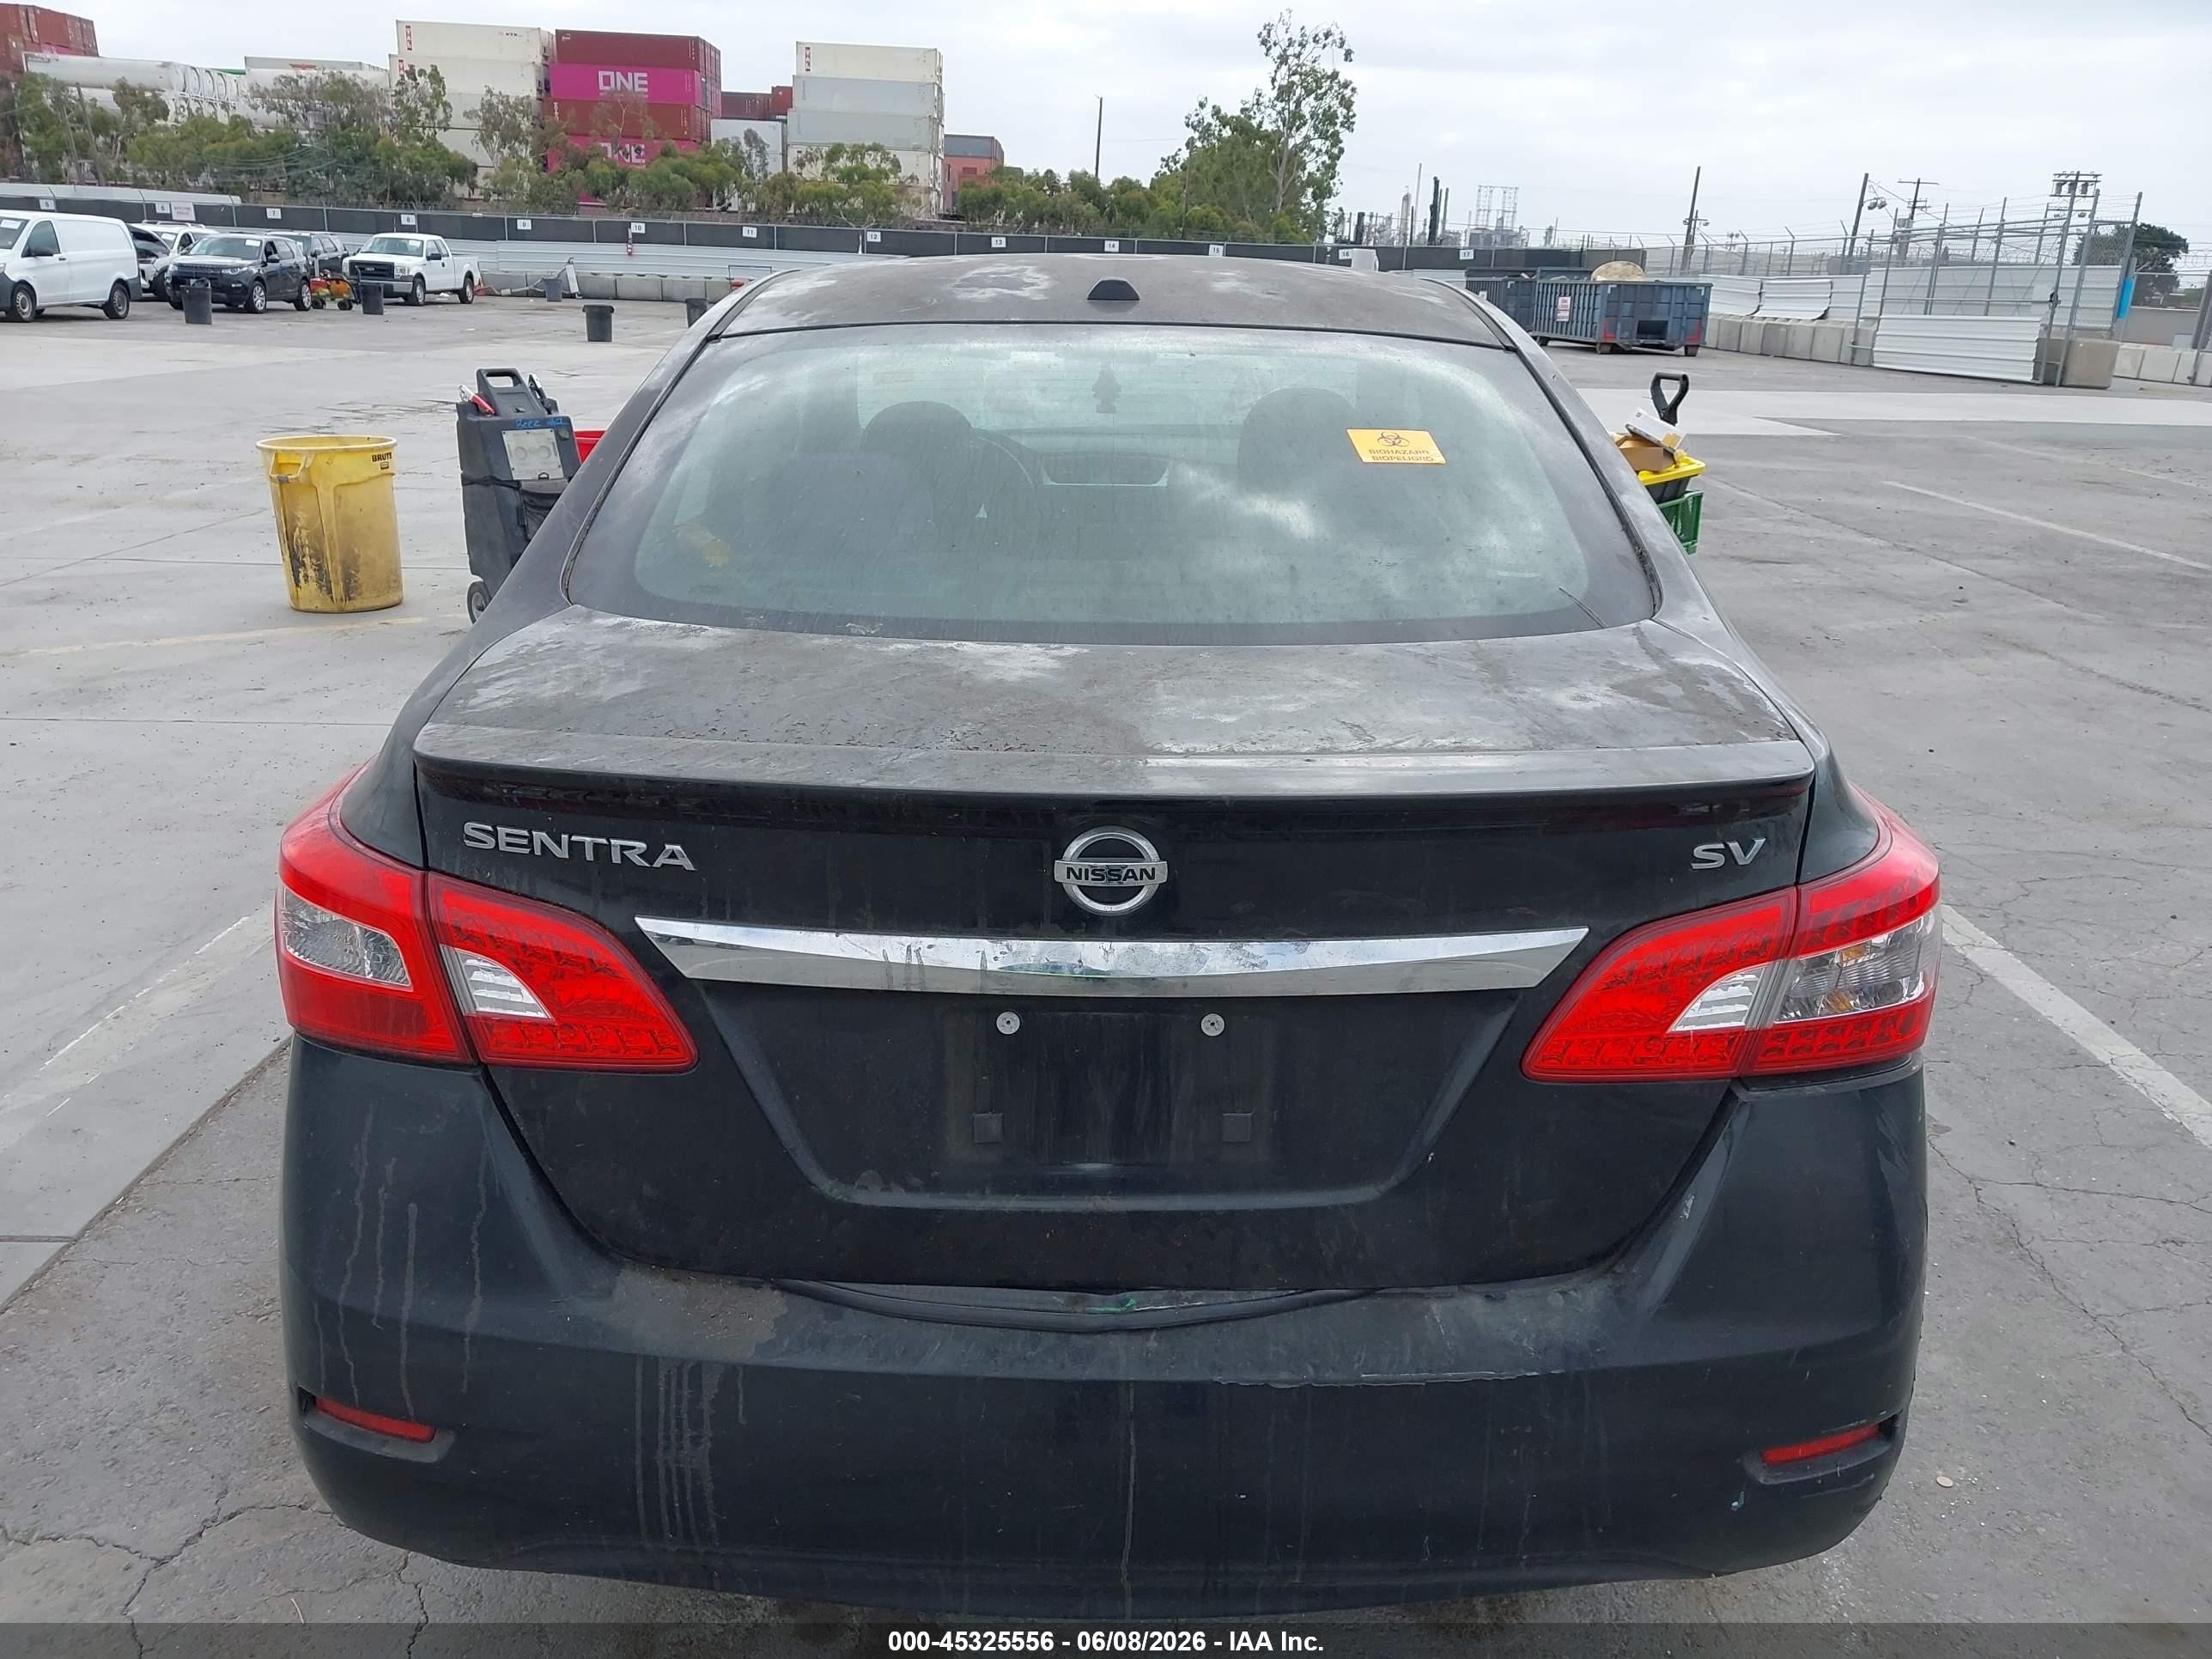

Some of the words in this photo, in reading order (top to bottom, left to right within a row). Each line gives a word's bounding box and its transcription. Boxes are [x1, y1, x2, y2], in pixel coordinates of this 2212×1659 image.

[599, 70, 648, 93] ONE
[463, 822, 697, 871] SENTRA
[1690, 837, 1766, 869] SV
[1066, 867, 1156, 881] NISSAN
